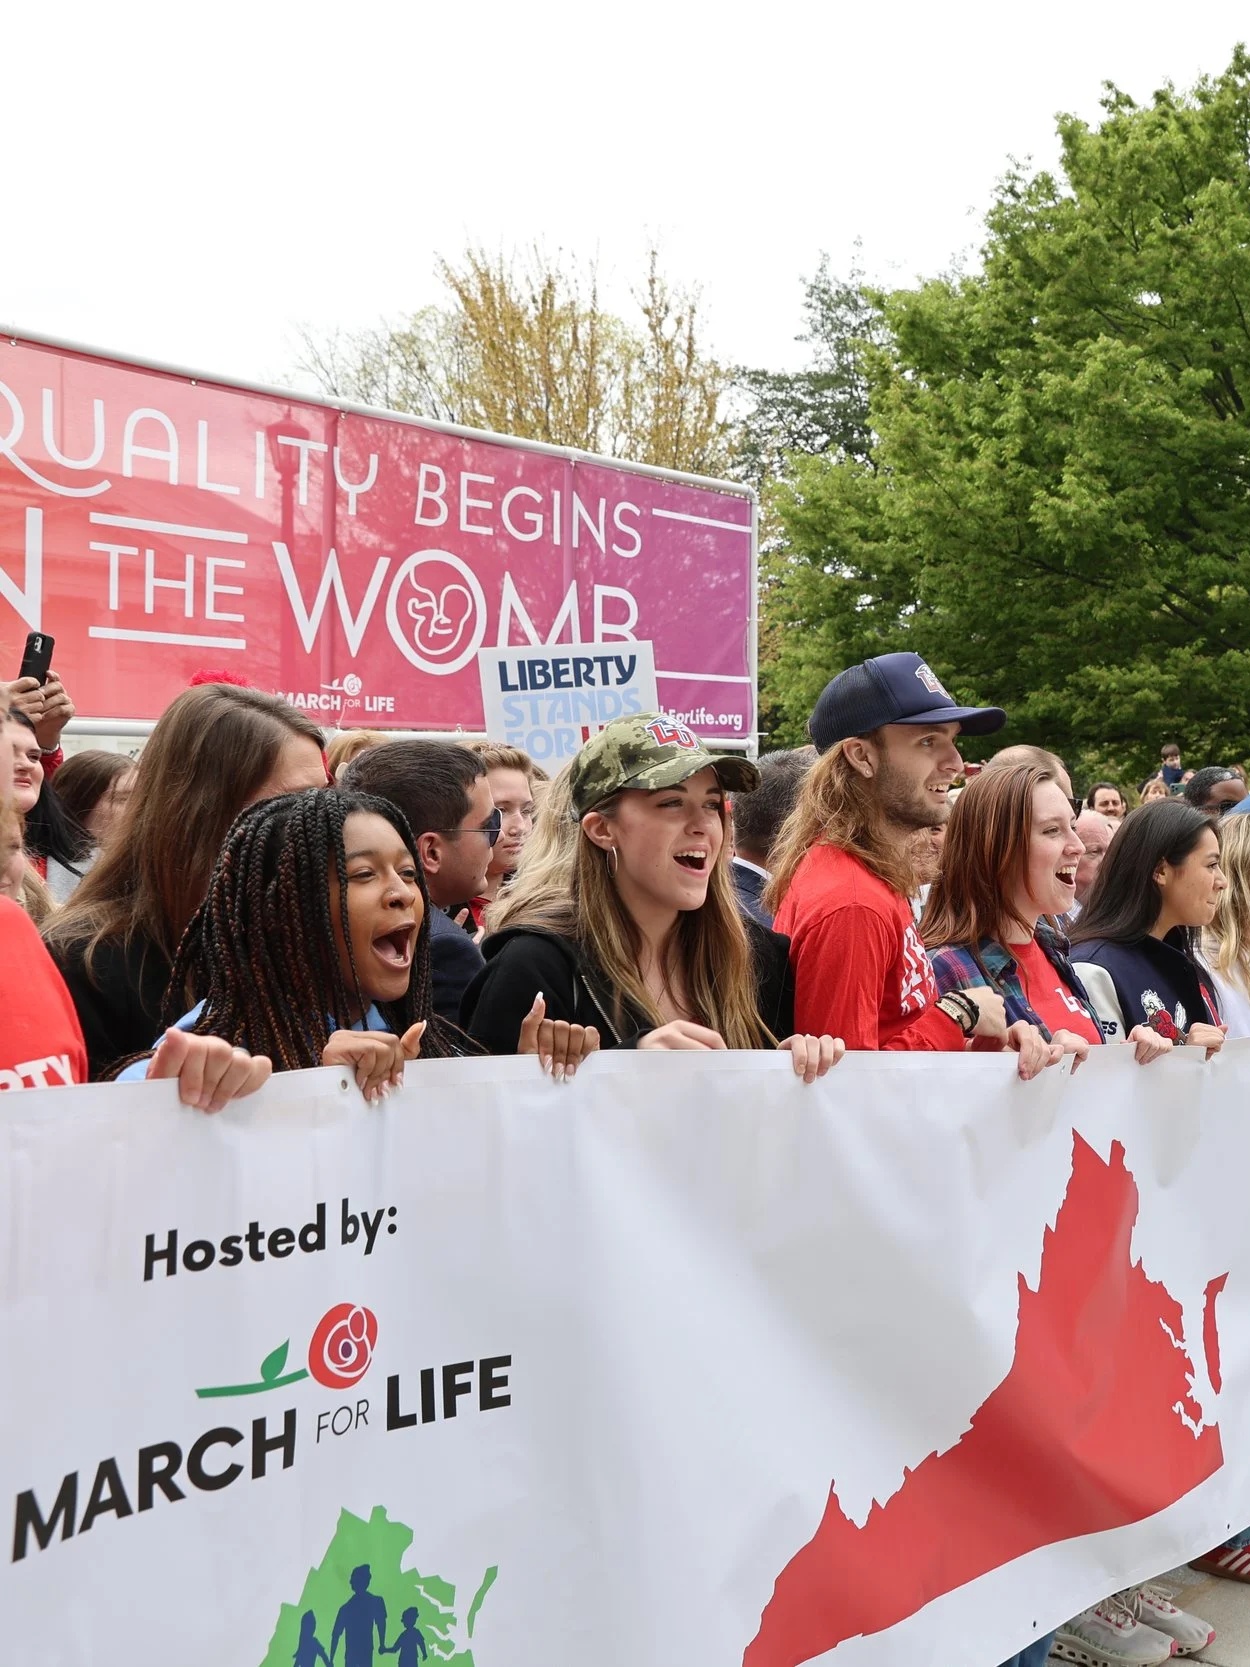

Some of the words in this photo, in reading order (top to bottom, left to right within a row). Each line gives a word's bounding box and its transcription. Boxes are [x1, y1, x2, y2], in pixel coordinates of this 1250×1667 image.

[414, 462, 643, 558] BEGINS
[90, 541, 246, 624] THE
[365, 696, 395, 712] LIFE
[498, 654, 636, 692] LIBERTY
[503, 687, 642, 728] STANDS
[143, 1203, 326, 1282] Hosted
[341, 1198, 398, 1255] by:
[11, 1407, 297, 1564] MARCH
[315, 1399, 371, 1444] FOR
[386, 1355, 513, 1432] LIFE
